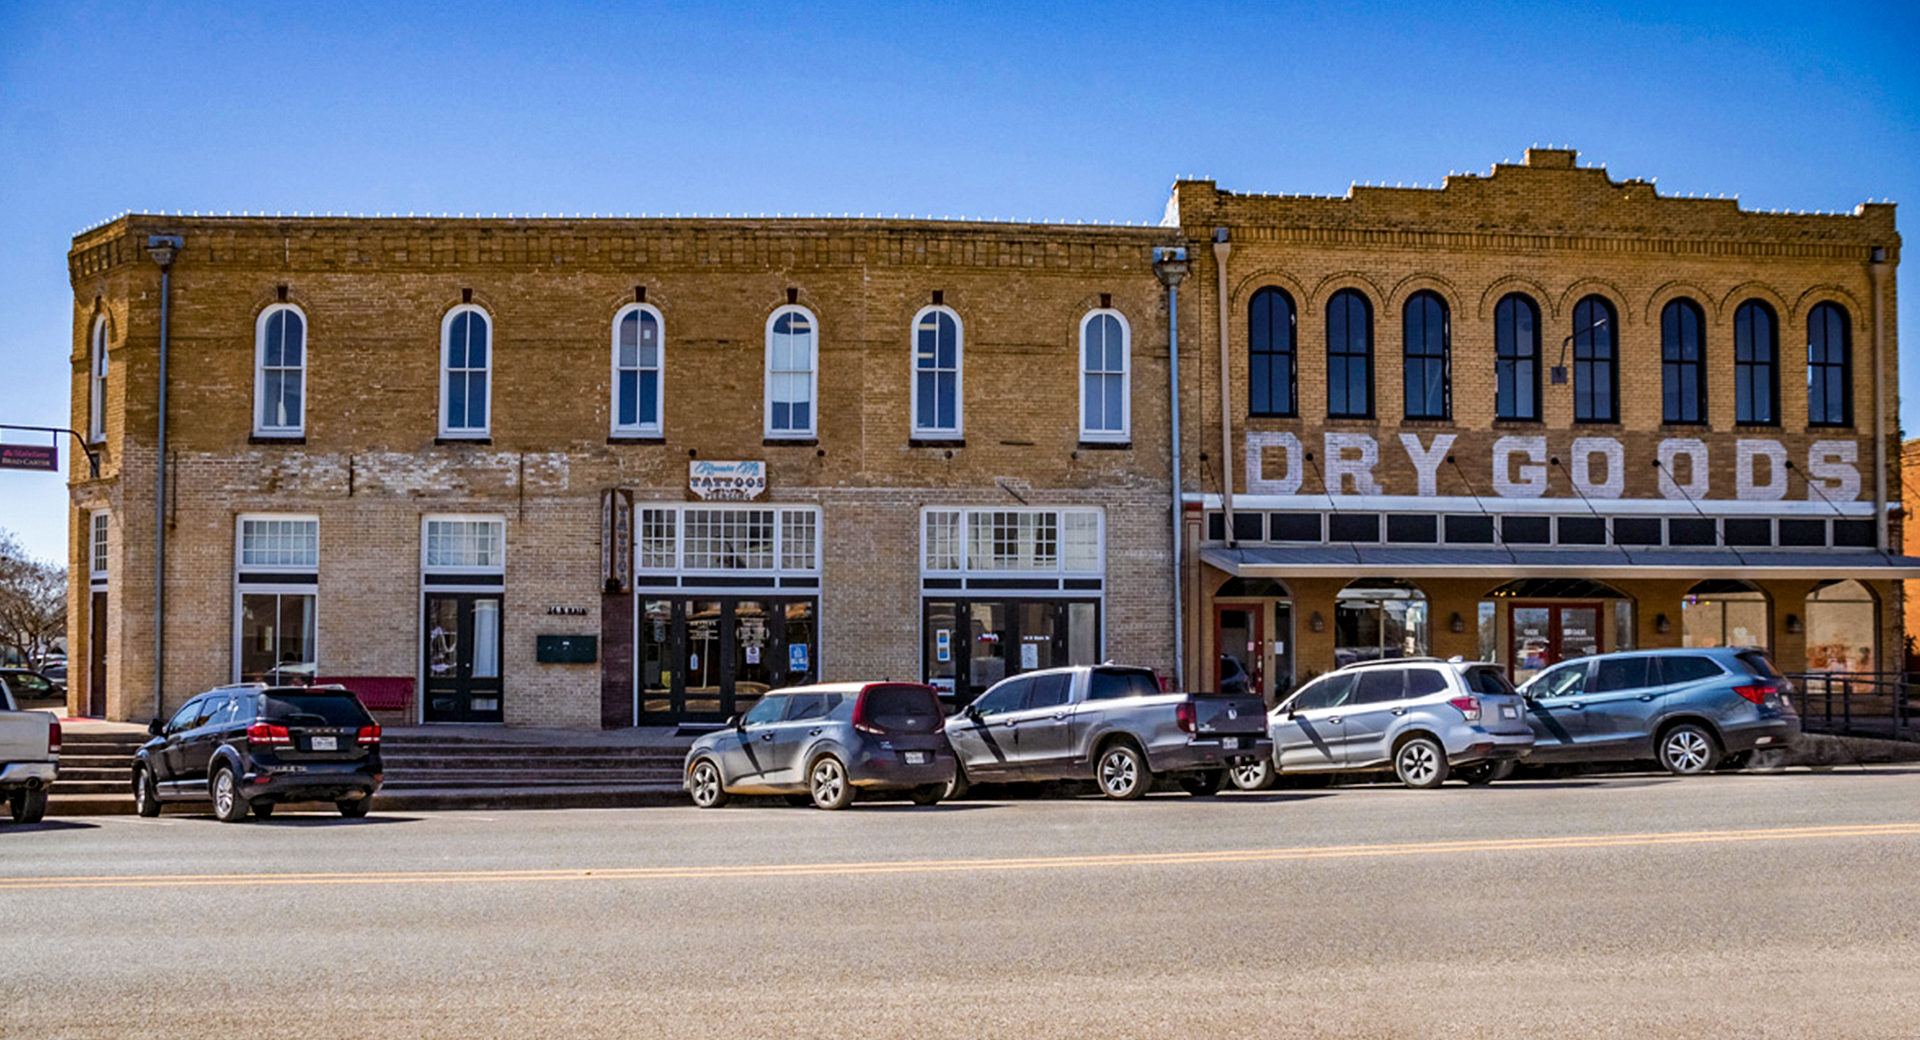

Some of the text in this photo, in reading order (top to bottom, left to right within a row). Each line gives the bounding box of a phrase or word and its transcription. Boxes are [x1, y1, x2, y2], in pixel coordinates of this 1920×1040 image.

[691, 477, 764, 487] TATTOOS
[1246, 431, 1862, 501] DRY GOODS
